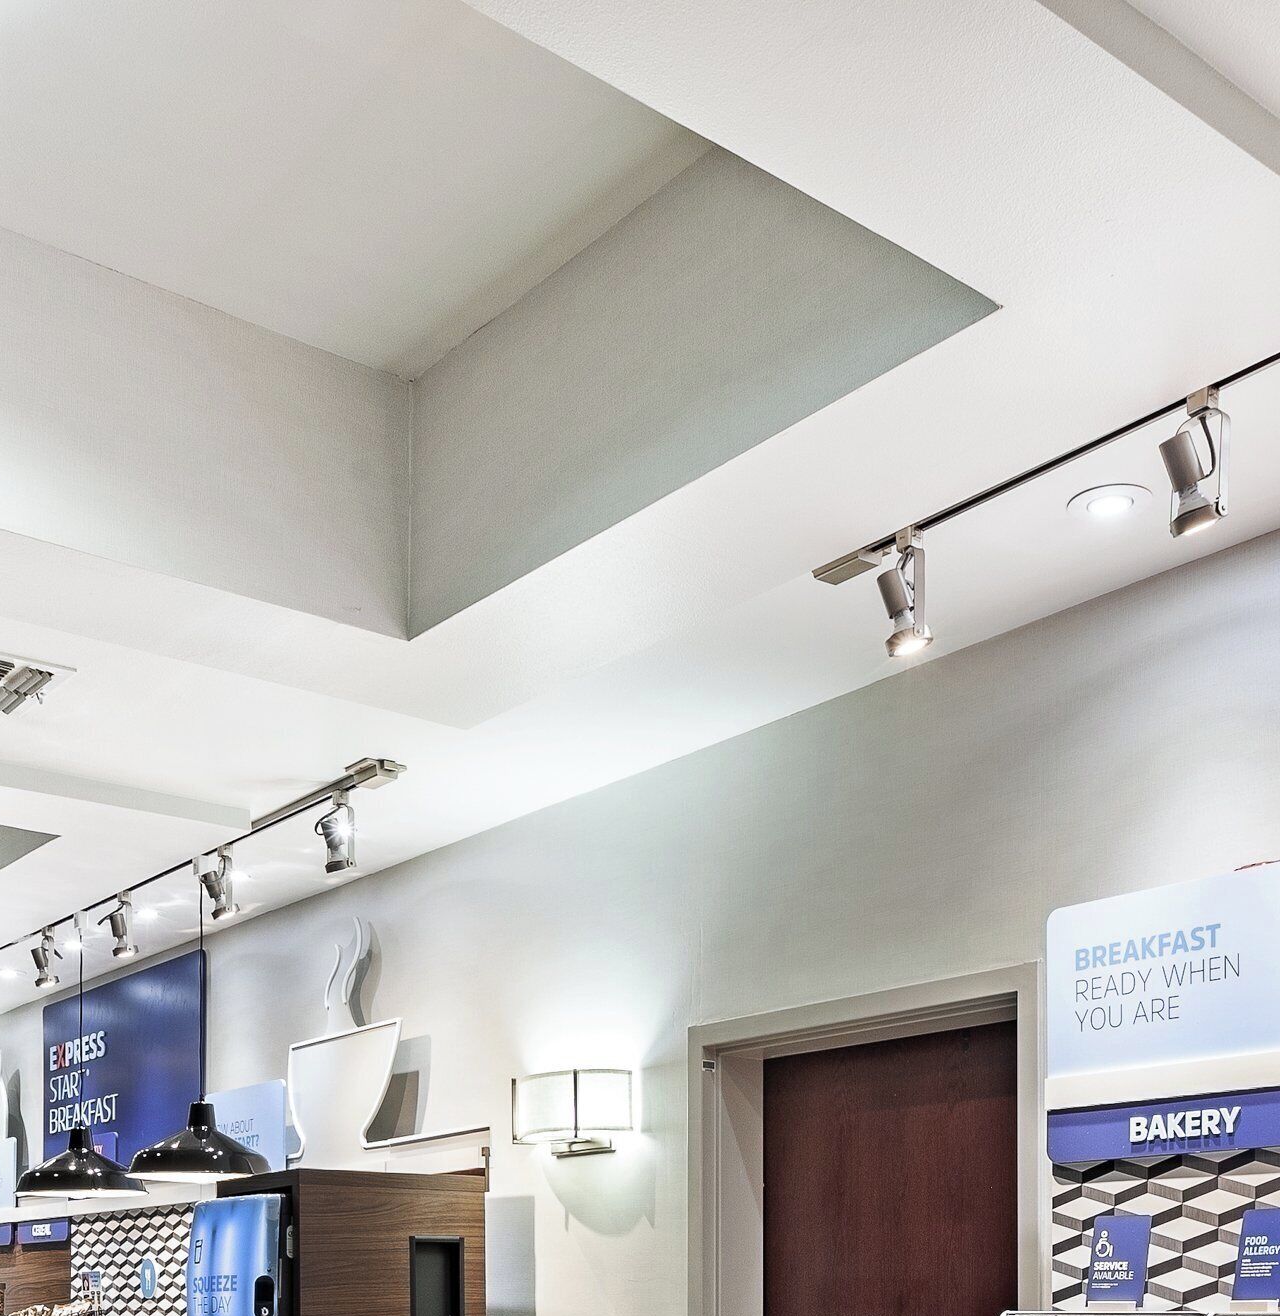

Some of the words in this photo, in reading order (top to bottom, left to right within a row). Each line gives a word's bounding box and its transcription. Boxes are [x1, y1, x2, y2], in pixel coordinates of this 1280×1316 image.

[1075, 923, 1221, 972] BREAKFAST
[1075, 967, 1152, 1003] READY
[1161, 952, 1240, 988] WHEN
[1074, 1003, 1123, 1033] YOU
[1132, 995, 1180, 1025] ARE
[49, 1030, 106, 1072] EXPRESS
[49, 1093, 119, 1135] BREAKFAST
[1129, 1106, 1242, 1143] BAKERY
[1244, 1235, 1268, 1246] FOOD
[192, 1274, 238, 1295] SQUEEZE
[1092, 1271, 1135, 1280] AVAILABLE
[1093, 1261, 1129, 1271] SERVICE
[192, 1297, 209, 1315] THE
[211, 1295, 232, 1315] DAY
